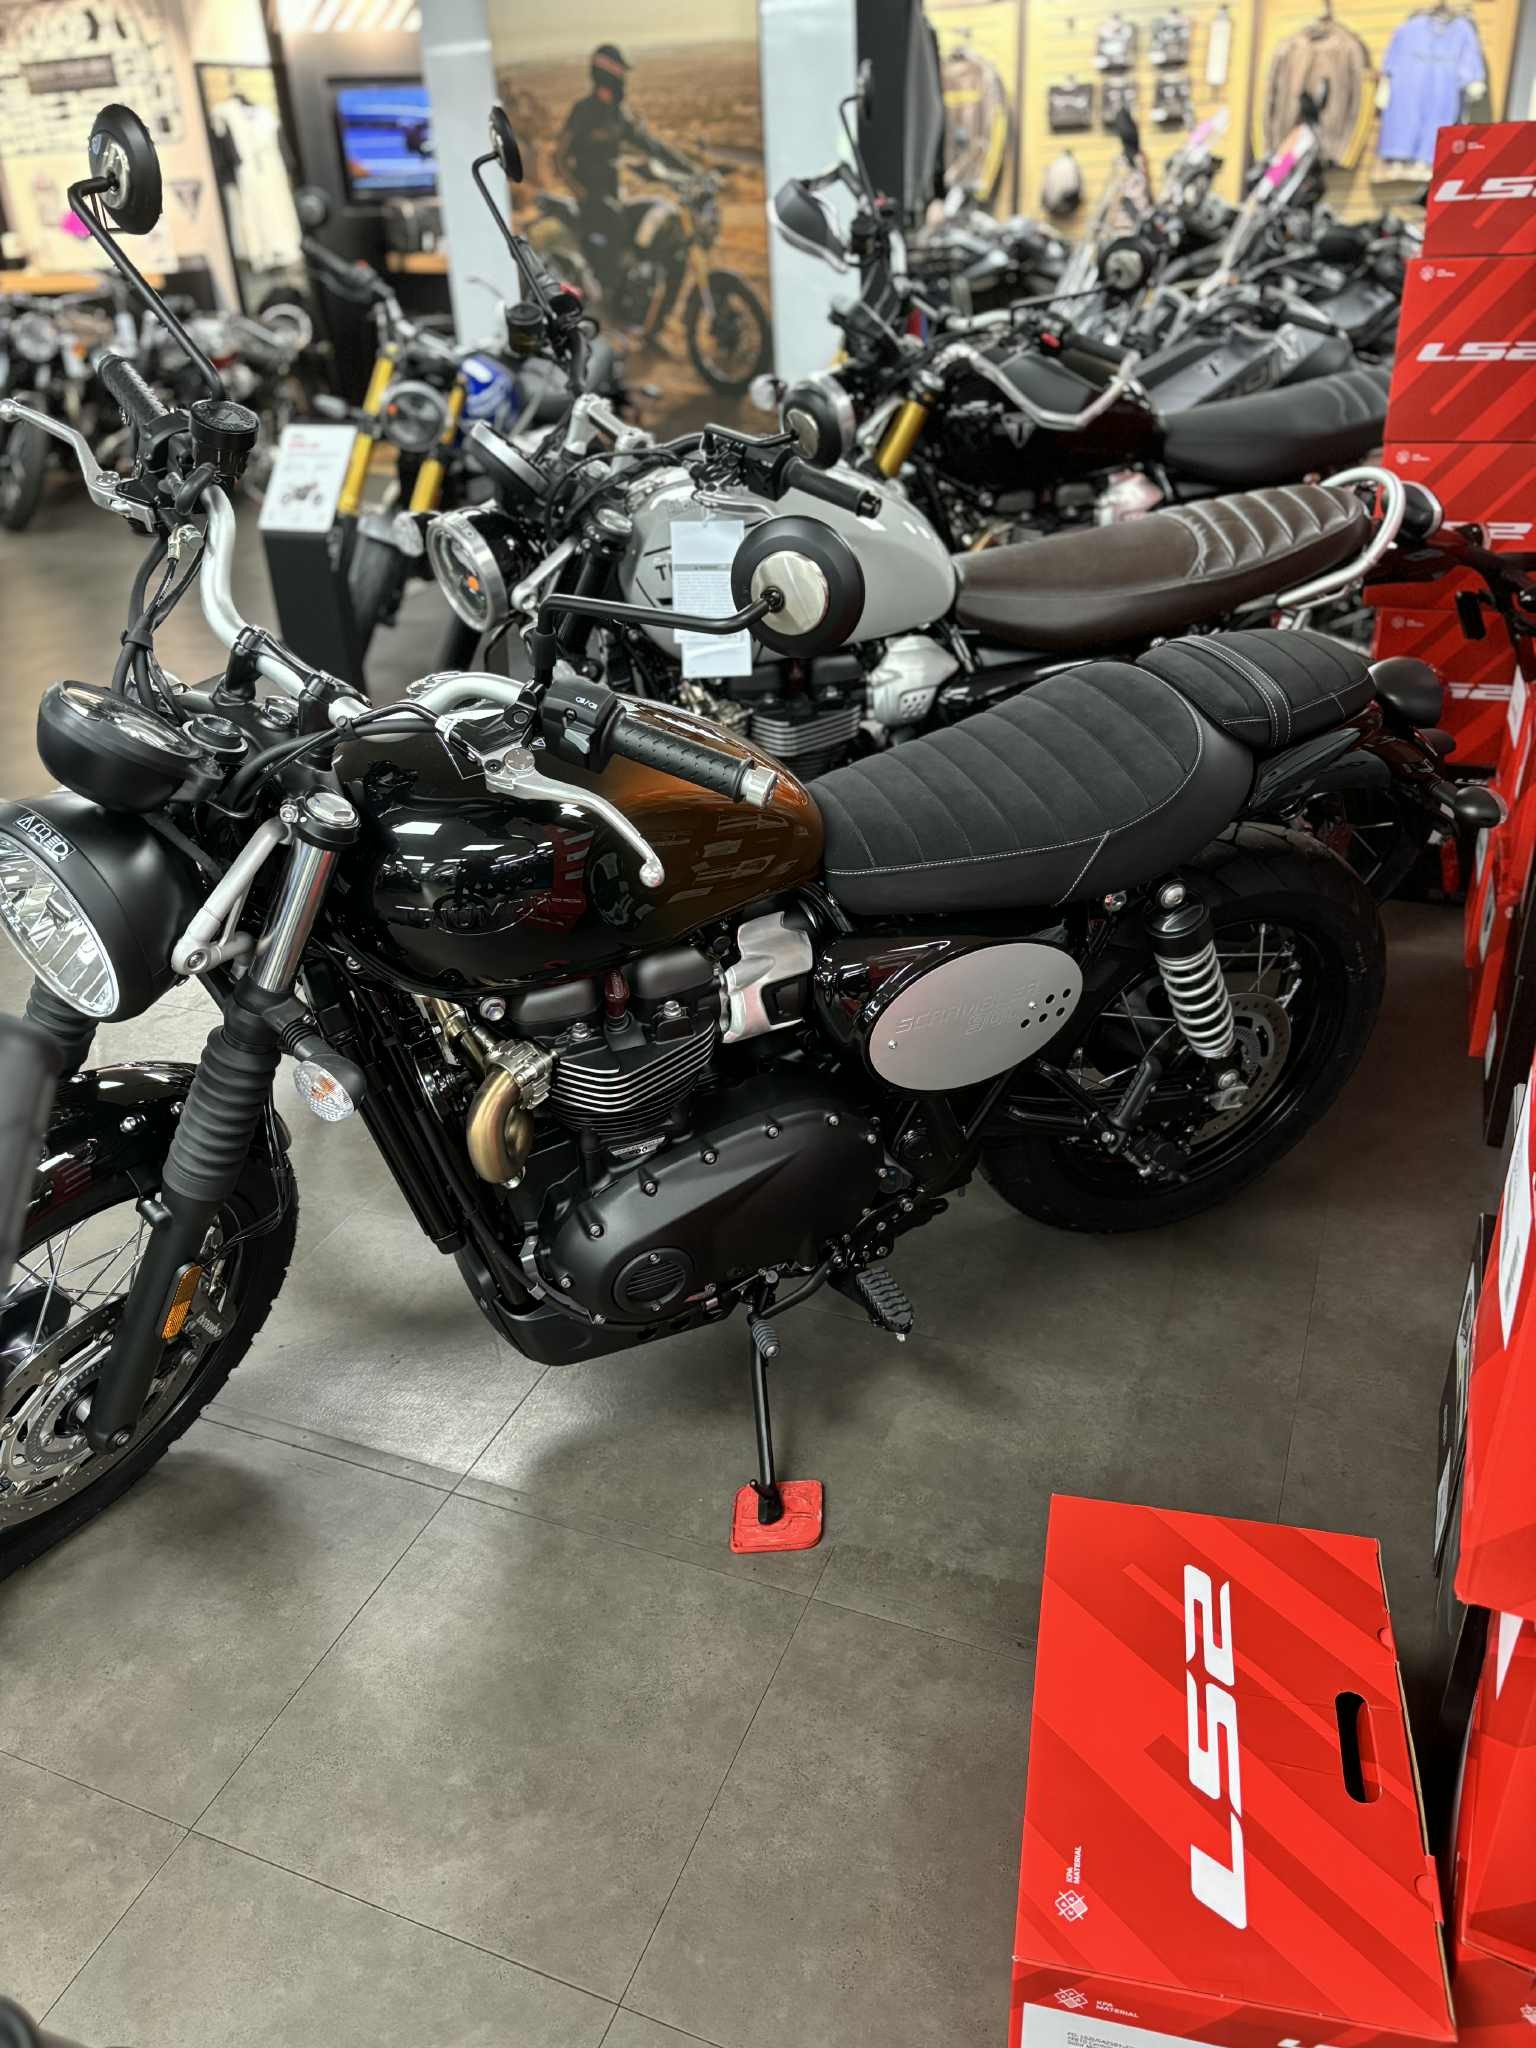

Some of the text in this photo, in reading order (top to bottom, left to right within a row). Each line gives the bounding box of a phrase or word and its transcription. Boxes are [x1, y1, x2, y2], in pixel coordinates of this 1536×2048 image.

[1434, 176, 1536, 202] LS
[1183, 1563, 1248, 1929] LS2
[1073, 1845, 1082, 1885] MATERIAL
[1096, 2005, 1140, 2018] MATERIAL
